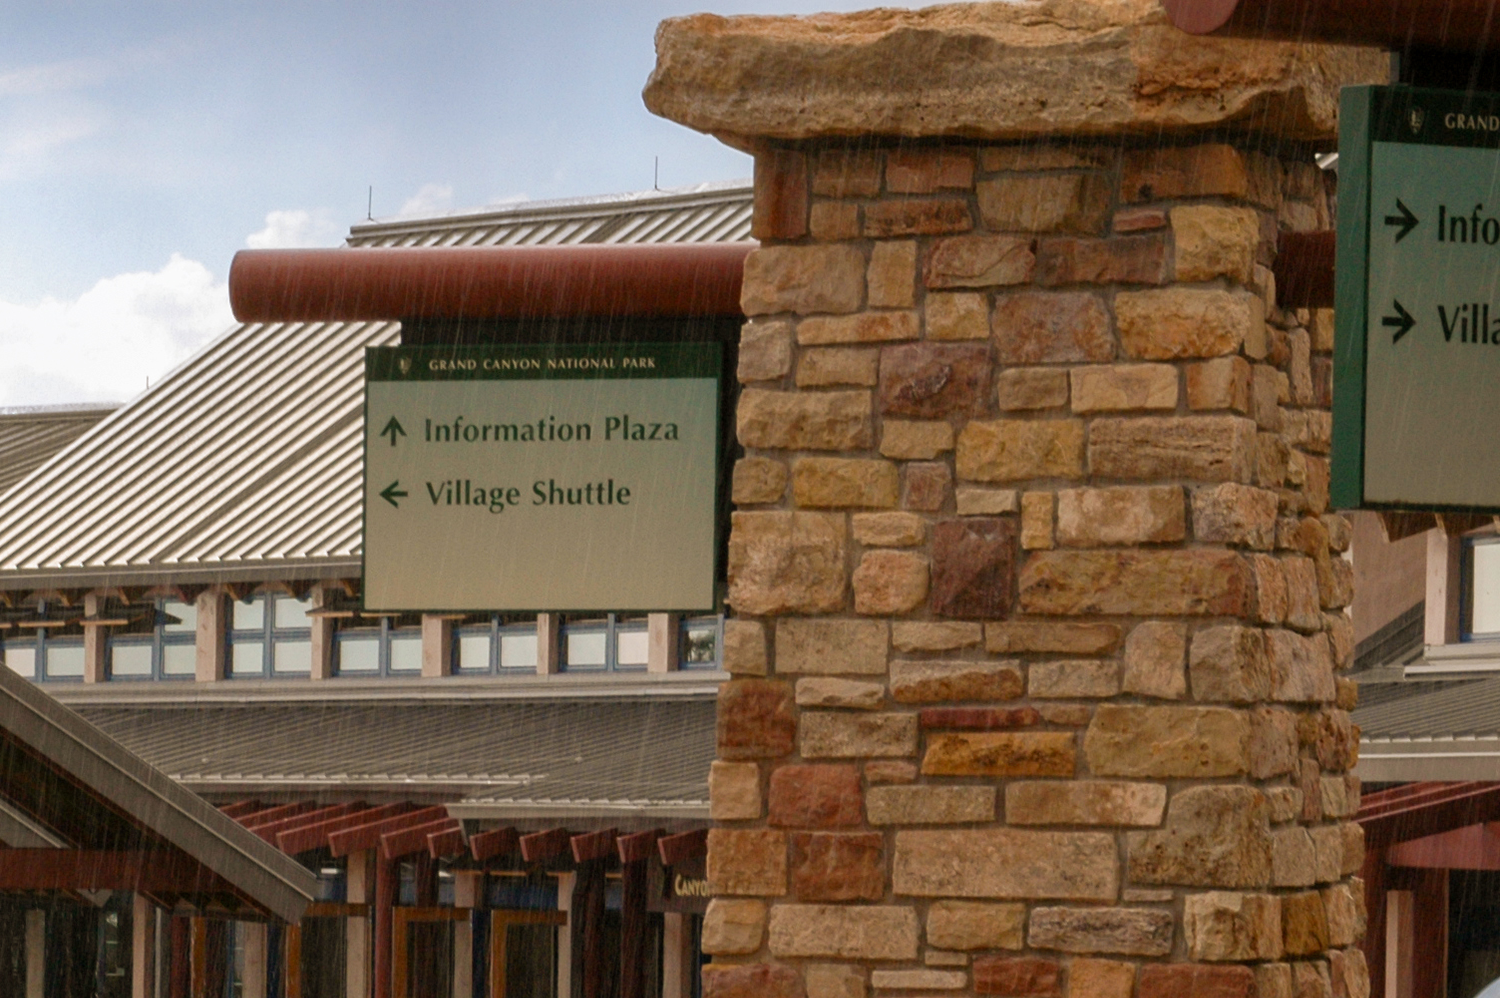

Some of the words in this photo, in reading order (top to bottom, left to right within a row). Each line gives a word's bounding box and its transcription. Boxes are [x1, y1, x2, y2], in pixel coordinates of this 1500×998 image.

[1444, 112, 1500, 132] GRAND
[1437, 203, 1500, 246] Info
[429, 358, 477, 371] GRAND
[483, 358, 541, 371] CANYON
[548, 357, 615, 370] NATIONAL
[623, 357, 656, 369] PARK
[425, 415, 592, 442] Information
[604, 414, 679, 441] Plaza
[425, 480, 520, 514] Village
[532, 479, 631, 506] Shuttle
